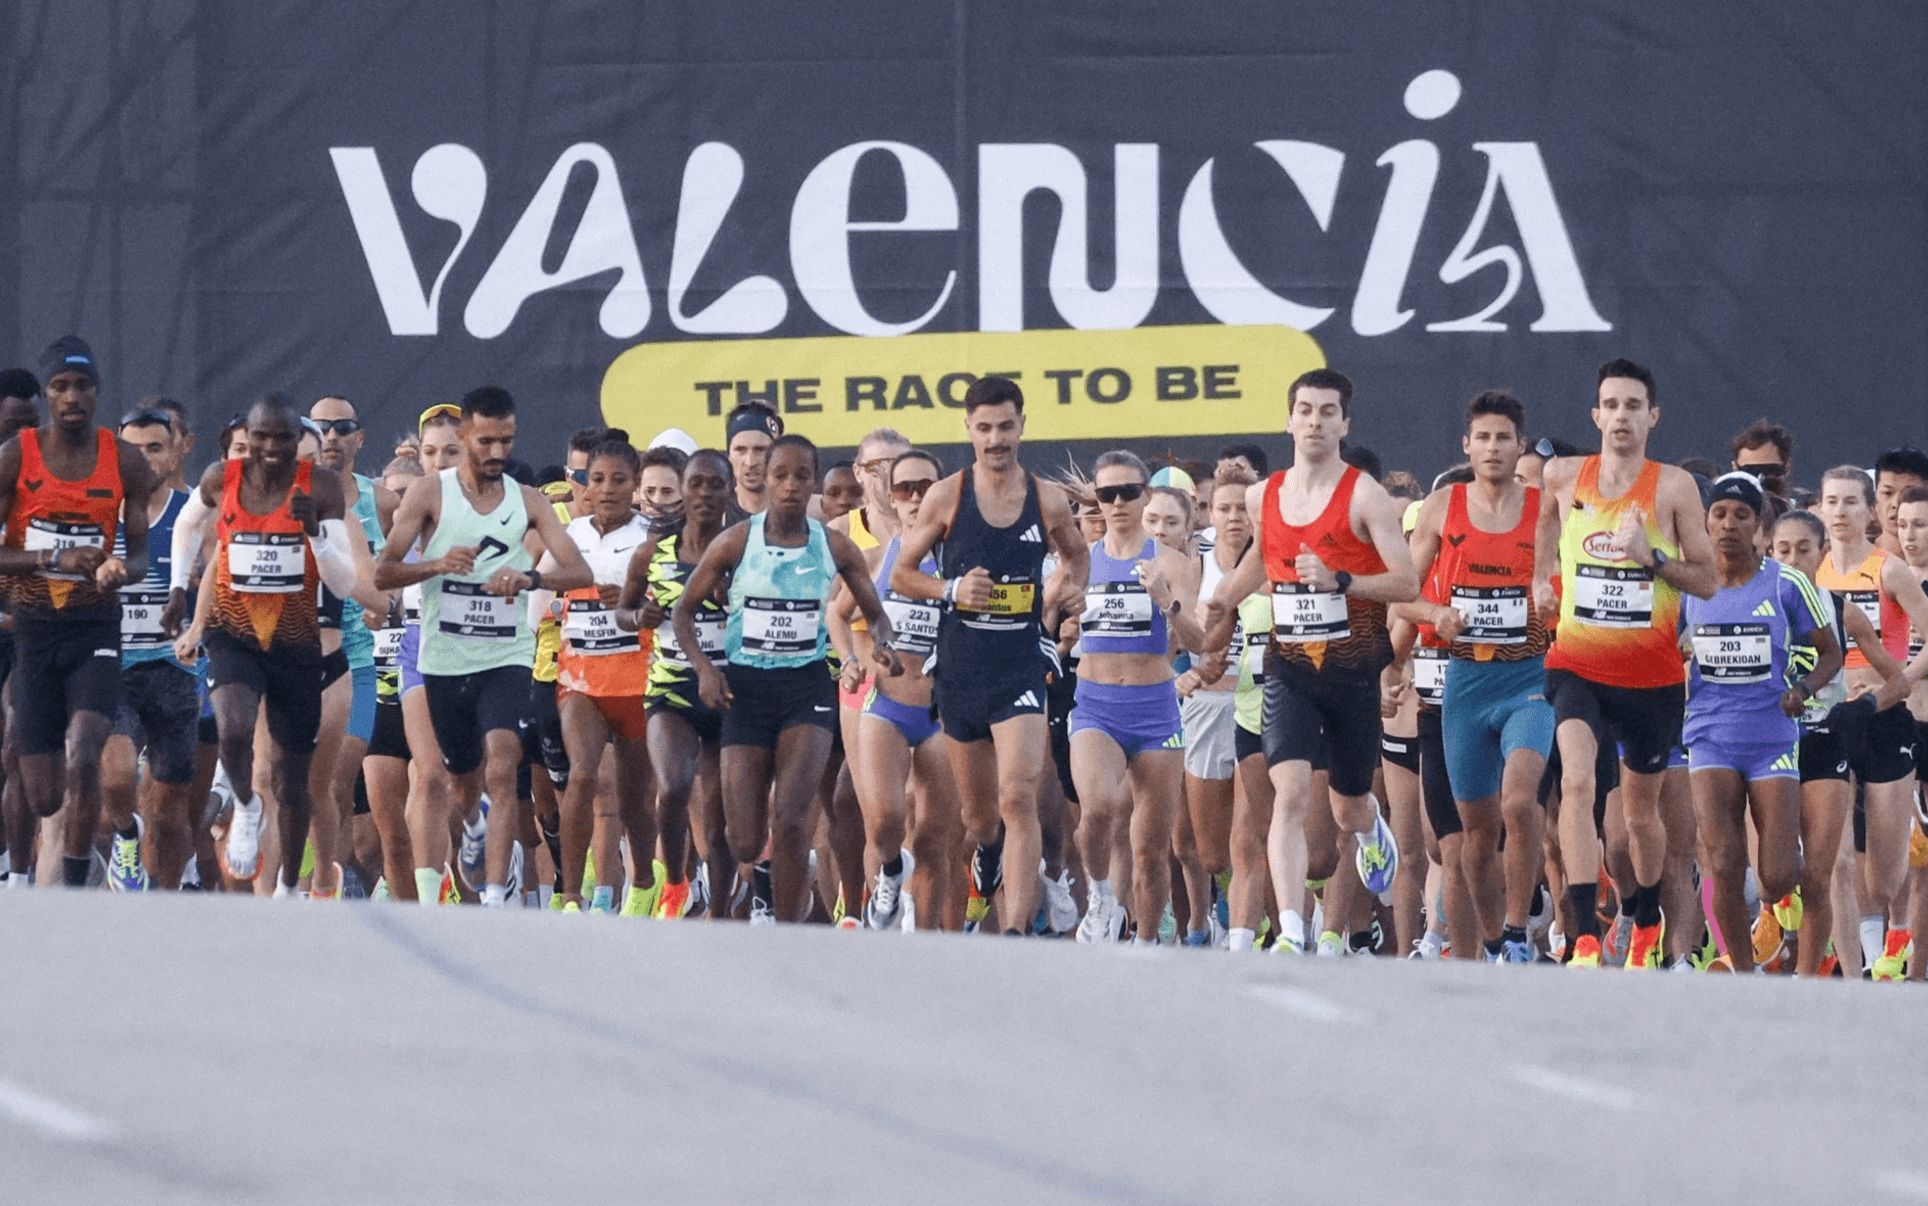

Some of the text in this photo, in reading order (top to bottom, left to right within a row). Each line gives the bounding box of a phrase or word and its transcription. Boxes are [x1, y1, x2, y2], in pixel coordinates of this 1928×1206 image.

[694, 364, 1242, 417] THE RAC TO BE
[256, 550, 278, 561] 320
[251, 564, 283, 574] PACER
[989, 589, 1008, 600] 56
[1601, 584, 1624, 596] 322
[470, 600, 492, 612] 318
[1104, 598, 1125, 609] 256
[1295, 599, 1316, 610] 321
[1477, 604, 1499, 614] 344
[1596, 598, 1628, 609] PACER
[127, 609, 148, 619] 190
[464, 614, 496, 624] PACER
[908, 609, 931, 622] 223
[1293, 612, 1323, 622] PACER
[588, 615, 608, 626] 204
[770, 615, 793, 628] 202
[1473, 616, 1504, 626] PACER
[583, 628, 616, 638] MESFIN
[765, 629, 798, 639] ALEMU
[1719, 641, 1741, 652] 203
